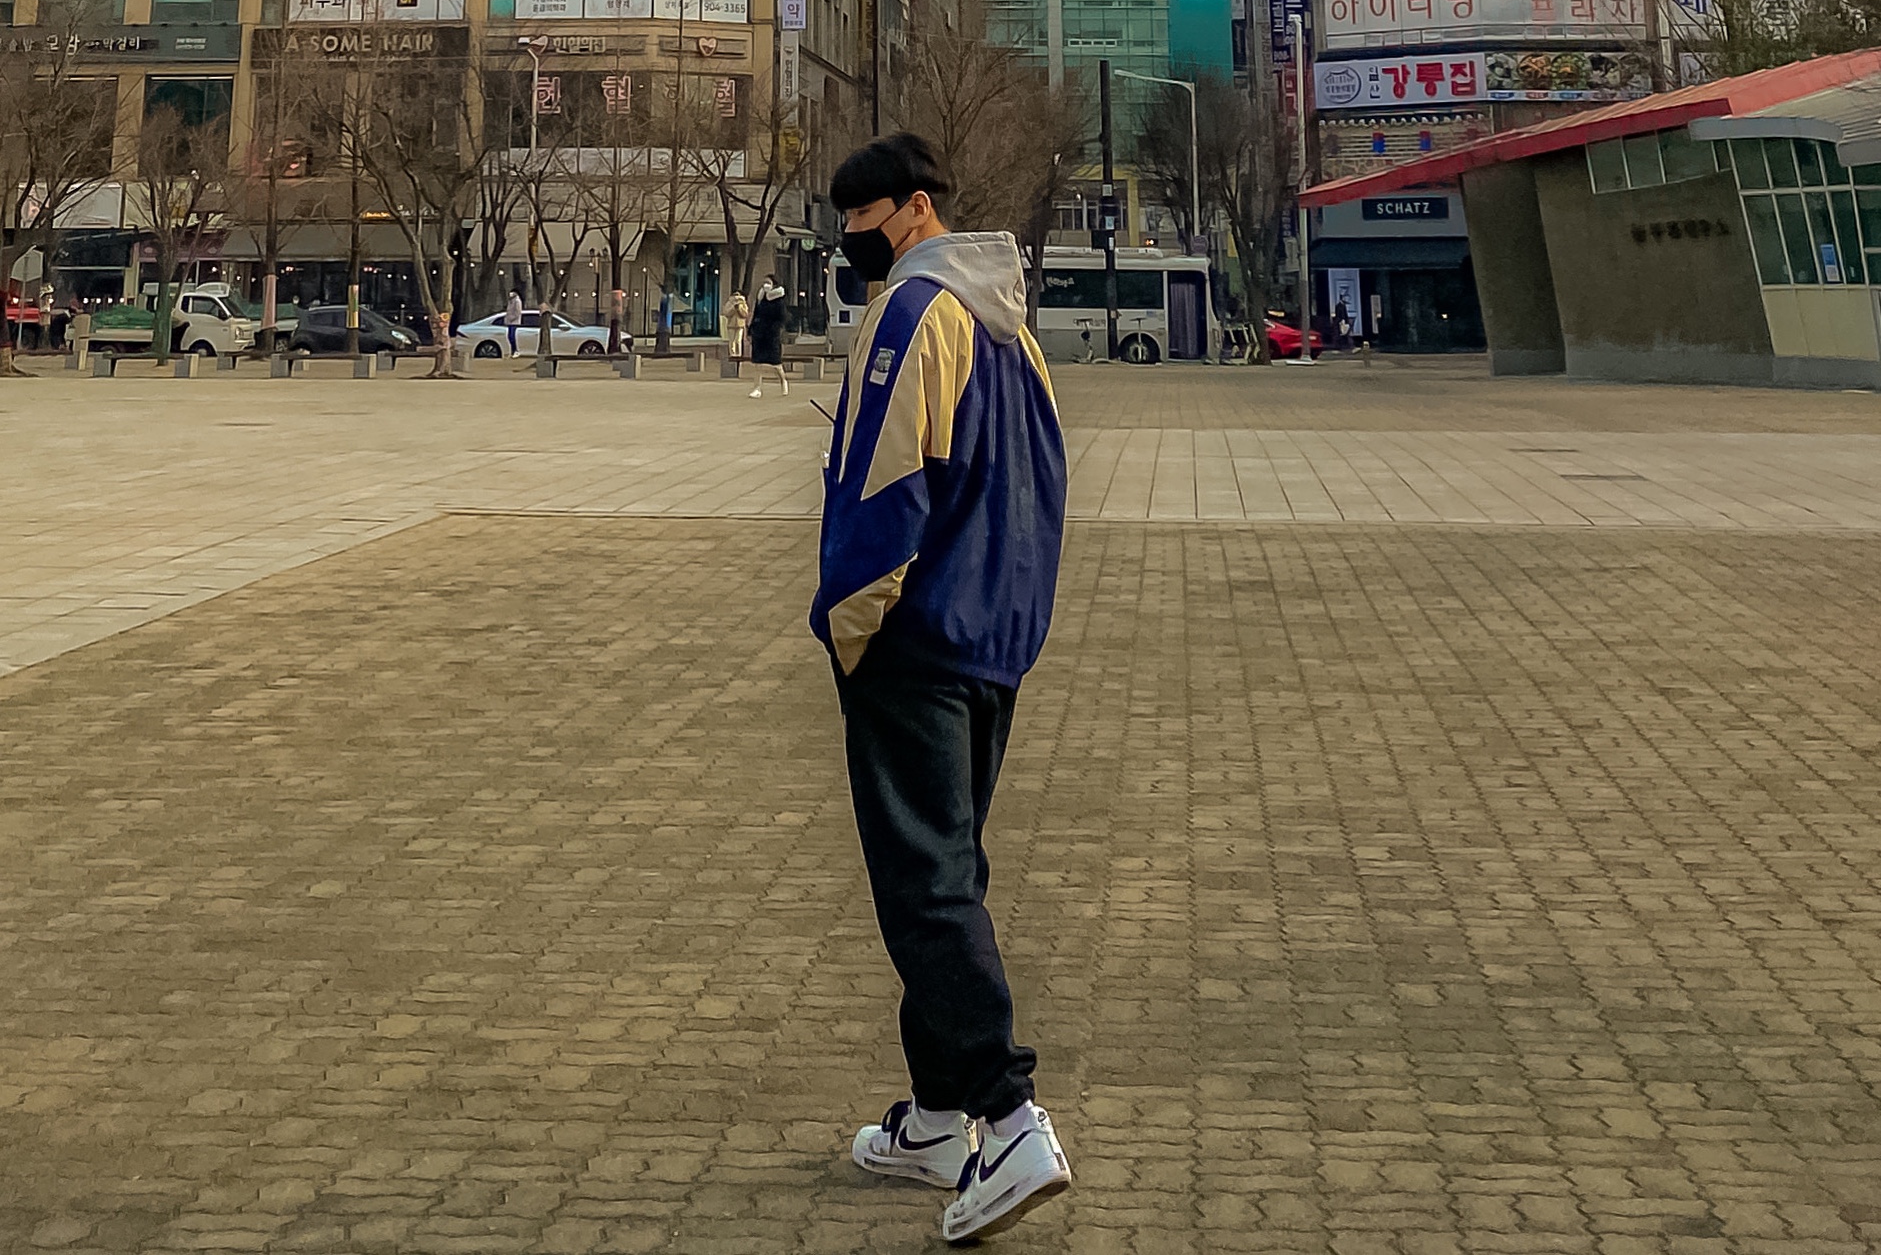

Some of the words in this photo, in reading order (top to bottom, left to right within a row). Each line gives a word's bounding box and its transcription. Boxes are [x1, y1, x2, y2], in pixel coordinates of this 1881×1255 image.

[704, 2, 746, 14] 904-3365
[787, 3, 801, 19] 약
[1382, 60, 1477, 99] 강릉집
[1376, 202, 1431, 215] SCHATZ
